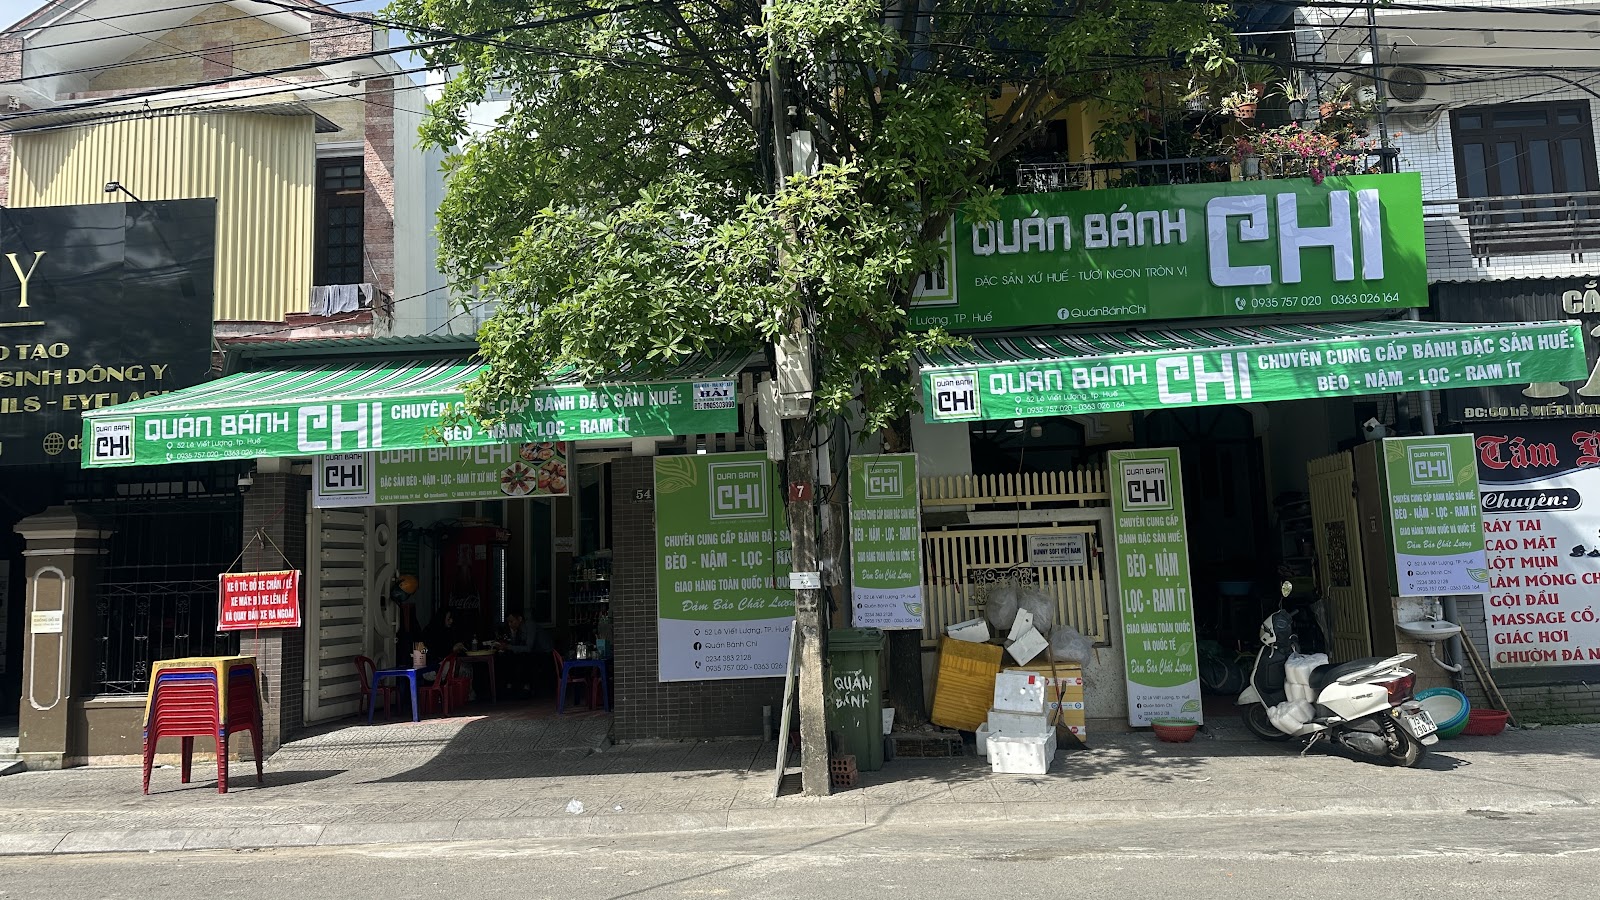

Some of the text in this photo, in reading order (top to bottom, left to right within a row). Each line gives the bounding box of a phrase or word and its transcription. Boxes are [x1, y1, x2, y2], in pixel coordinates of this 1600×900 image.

[972, 188, 1385, 288] QUÁN BÁNH CHI
[5, 251, 47, 308] Y
[975, 274, 998, 288] ĐẶC
[1002, 271, 1023, 284] SẢN
[1028, 272, 1043, 284] XỨ
[1047, 269, 1069, 282] HUẾ
[1107, 268, 1140, 278] NGON
[1146, 264, 1172, 277] TRÒN
[1177, 266, 1188, 277] VỊ
[1251, 292, 1399, 308] 0935 757 020 0363 026 164
[972, 311, 992, 322] Huế
[1071, 304, 1146, 318] QuánBánhChi
[15, 342, 70, 361] TẠO
[1258, 328, 1575, 370] CHUYÊN CUNG CẤP BÁNH ĐẶC SẢN HUẾ:
[66, 363, 168, 385] ĐÔNG Y
[990, 352, 1252, 404] QUÁN BÁNH CHI
[1316, 360, 1522, 391] BÈO NẬM LỌC RAM ÍT
[938, 390, 975, 412] CHI
[1102, 390, 1118, 398] Huế
[391, 385, 682, 420] CHUYÊN BÁNH ĐẶC SẢN HUẾ:
[1098, 402, 1110, 410] 026
[1510, 402, 1564, 416] LÊ VIẾT
[144, 402, 382, 452] QUÁN BÁNH CHI
[537, 414, 631, 438] LỌC RAM ÍT
[96, 435, 130, 457] CHI
[197, 436, 262, 448] Viết Huế
[177, 452, 194, 460] 0935
[224, 450, 240, 458] 0363
[326, 464, 362, 488] CHI
[1414, 459, 1448, 478] CHI
[456, 472, 470, 484] RAM
[870, 477, 898, 493] CHI
[636, 489, 652, 500] 54
[718, 484, 760, 510] CHI
[796, 486, 805, 498] 7
[1128, 480, 1166, 502] CHI
[1482, 492, 1569, 510] Chuyên:
[1120, 513, 1178, 528] CHUYÊN CUNG CẤP
[1394, 505, 1468, 521] BÈO NẬM LỌC RAM
[1484, 518, 1542, 533] RÁY TAI
[664, 530, 759, 547] CHUYÊN CUNG CẤP BÁNH
[1118, 530, 1166, 546] BÁNH ĐẶC SẢN
[1486, 536, 1557, 554] CẠO MẶT
[665, 550, 762, 570] BÈO NẬM LỌC
[1126, 548, 1180, 582] BÈO NẬM
[1520, 556, 1558, 570] MỤN
[227, 580, 266, 592] XE TÔ: XE
[674, 574, 762, 592] GIAO HÀNG TOÀN QUỐC
[1489, 572, 1576, 588] LÀM MÓNG
[231, 596, 238, 606] XE
[262, 595, 269, 605] XE
[682, 597, 765, 612] Đảm Bảo Chất
[1124, 582, 1186, 618] LỌC RAM ÍT
[1490, 590, 1560, 608] GỘI ĐẦU
[233, 609, 276, 622] QUAY XE RA
[1492, 611, 1566, 626] MASSAGE
[704, 628, 712, 636] 52
[1126, 619, 1190, 634] GIAO TOÀN QUỐC
[705, 640, 758, 650] Quán Bánh Chi
[1143, 637, 1168, 651] VÀ QUỐC
[1494, 630, 1569, 644] GIÁC HƠI
[722, 654, 734, 662] 383
[1496, 646, 1584, 664] CHƯỜM ĐÁ
[771, 662, 782, 670] 026
[834, 669, 872, 691] QUÁN
